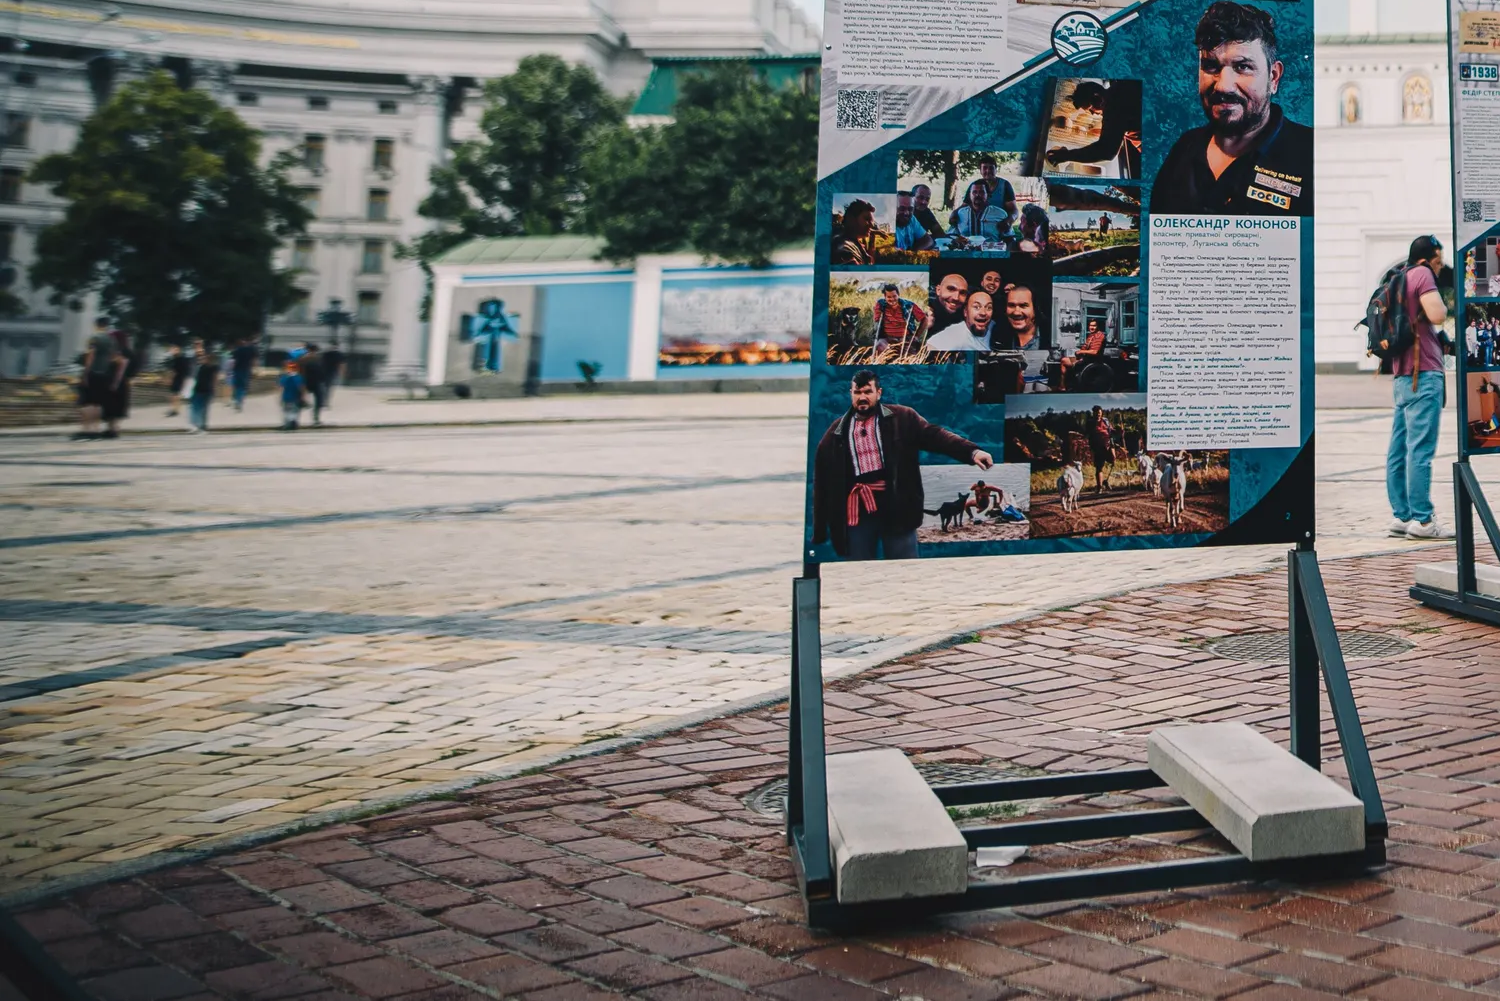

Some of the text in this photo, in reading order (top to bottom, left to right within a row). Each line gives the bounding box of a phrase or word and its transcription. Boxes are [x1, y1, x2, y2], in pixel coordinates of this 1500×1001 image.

[1472, 66, 1497, 78] 1938
[1251, 190, 1286, 206] FOCUS
[1154, 218, 1296, 230] ОЛЕКСАНДР КОНОНОВ
